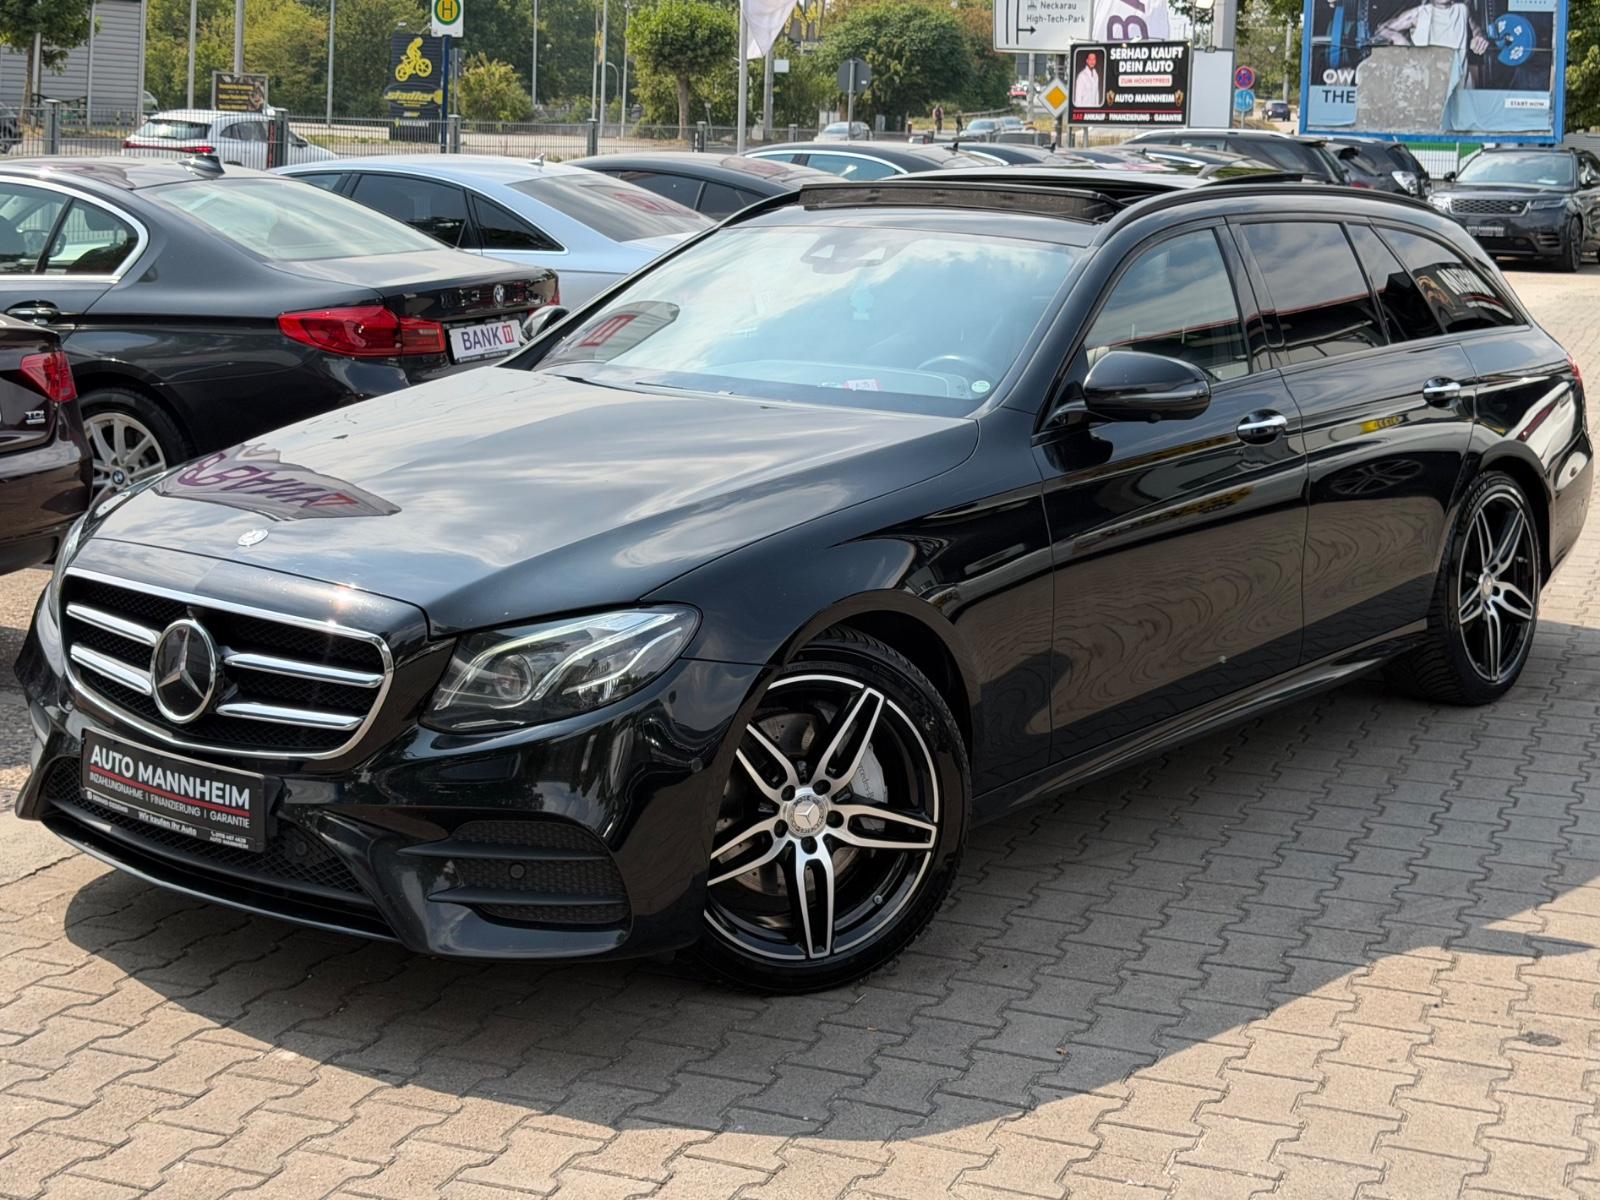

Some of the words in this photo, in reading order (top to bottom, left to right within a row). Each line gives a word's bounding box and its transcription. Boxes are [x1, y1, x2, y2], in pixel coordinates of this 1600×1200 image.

[1040, 1, 1077, 10] Neckarau
[1026, 14, 1085, 25] High-Tech-Park
[1110, 47, 1149, 60] SERHAD
[1151, 46, 1184, 59] KAUFT
[1119, 60, 1144, 72] DEIN
[1145, 60, 1174, 72] AUTO
[1115, 93, 1134, 103] AUTO
[1135, 93, 1175, 103] MANNHEIM
[1322, 90, 1355, 104] THE
[1109, 113, 1150, 121] FINANZIERUNG
[1153, 113, 1183, 121] GARANTIE
[461, 326, 502, 351] BANK
[24, 409, 45, 420] TDI
[90, 745, 134, 778] AUTO
[138, 761, 249, 809] MANNHEIM
[150, 793, 201, 817] FINANZIERUNG
[209, 811, 250, 829] GARANTIE
[138, 811, 150, 821] Wir
[149, 814, 171, 829] kaufen
[180, 824, 197, 836] Auto
